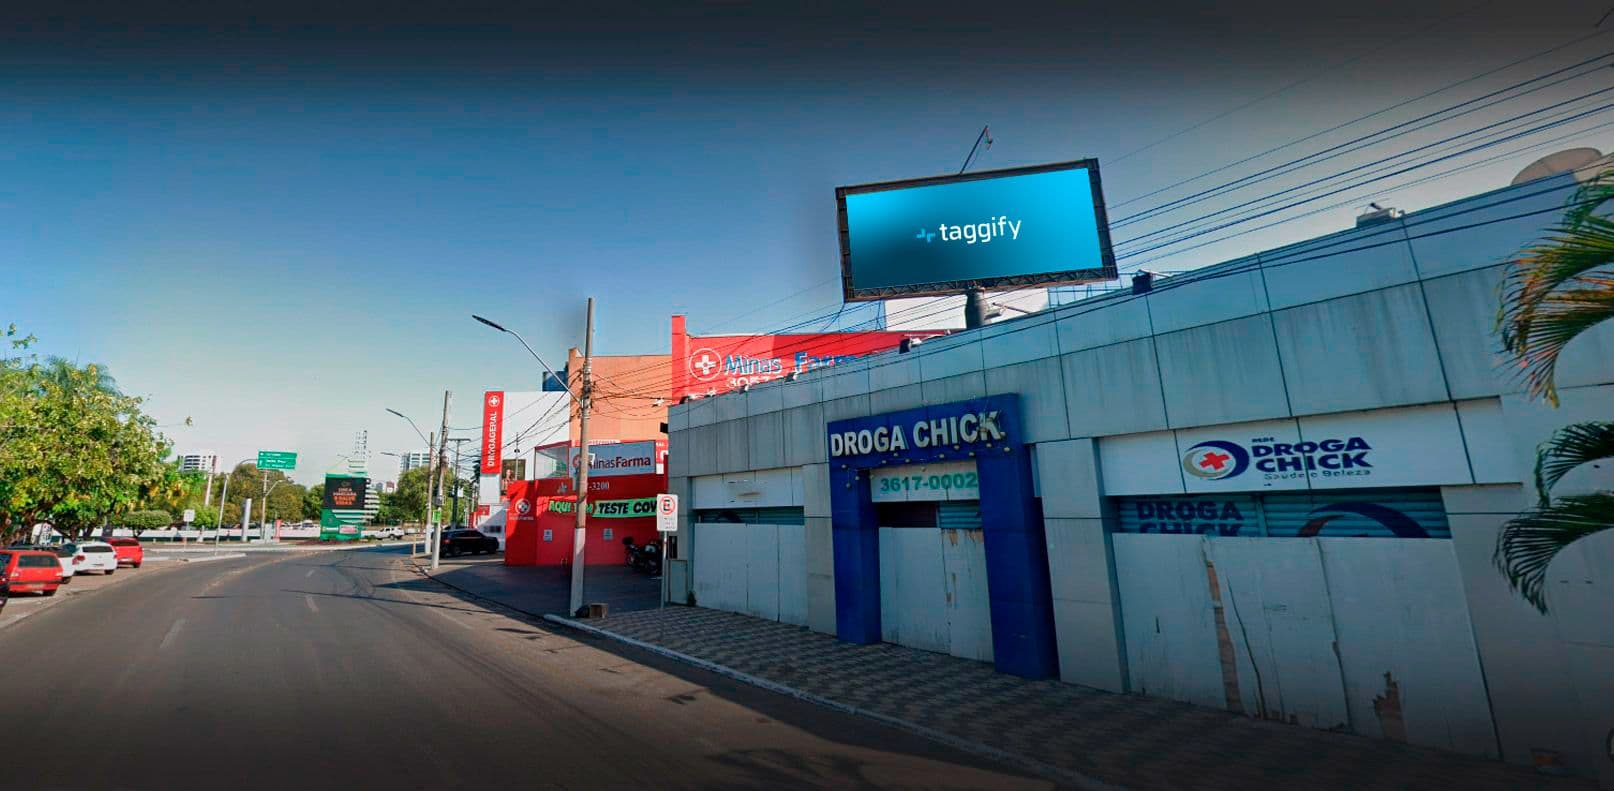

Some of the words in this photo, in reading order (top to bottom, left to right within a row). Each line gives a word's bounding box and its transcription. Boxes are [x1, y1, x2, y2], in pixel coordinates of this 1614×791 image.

[939, 216, 1022, 244] taggify
[724, 353, 783, 375] Minas
[487, 411, 497, 467] DROGAGERAL
[830, 425, 909, 457] DROGA
[913, 411, 1003, 448] CHICK
[1252, 437, 1372, 458] DROGA
[588, 455, 651, 470] inasFarma
[1256, 451, 1374, 473] CHICK
[880, 472, 978, 492] 3617-0002
[548, 500, 571, 513] AQUI
[573, 502, 593, 513] TM
[599, 502, 629, 515] TESTE
[1136, 501, 1245, 520] DROGA
